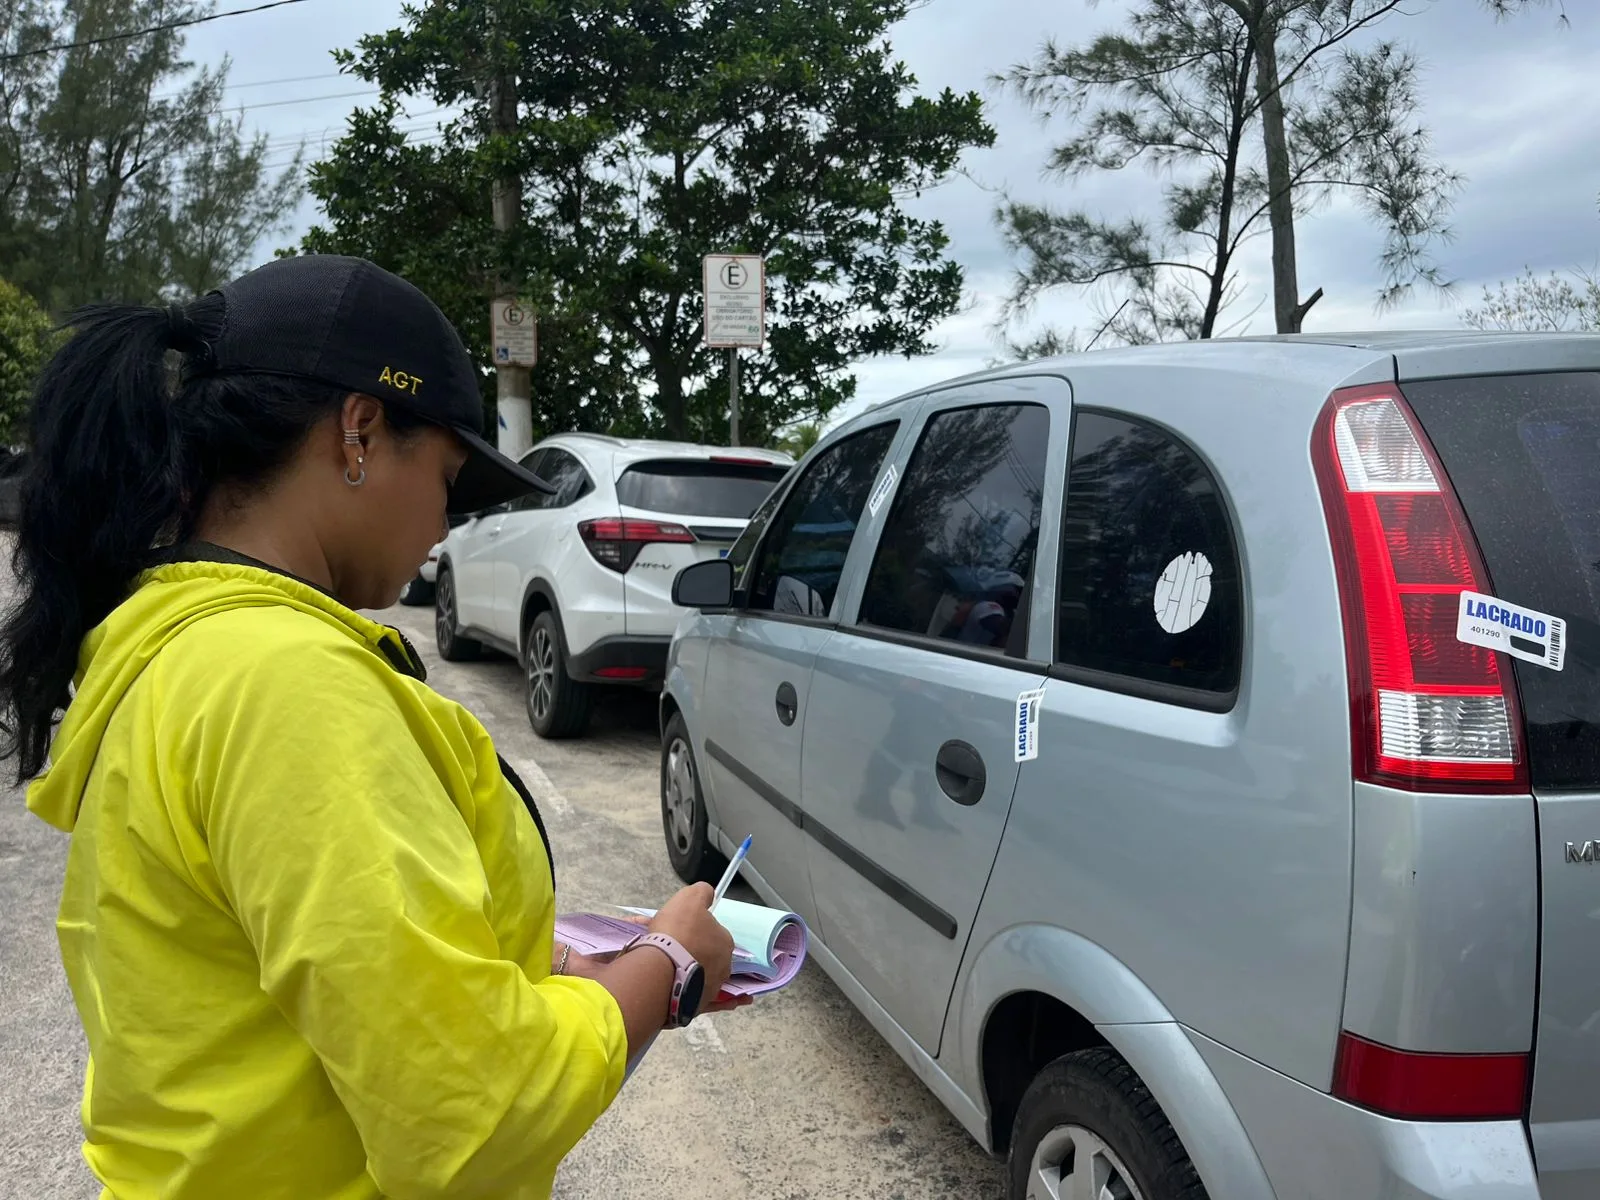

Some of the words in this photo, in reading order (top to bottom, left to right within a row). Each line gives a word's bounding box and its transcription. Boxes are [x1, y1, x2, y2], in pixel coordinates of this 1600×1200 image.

[728, 265, 740, 286] E
[378, 366, 423, 395] AGT
[1466, 599, 1546, 638] LACRADO
[1470, 625, 1501, 638] 401290
[1018, 702, 1029, 757] LACRADO
